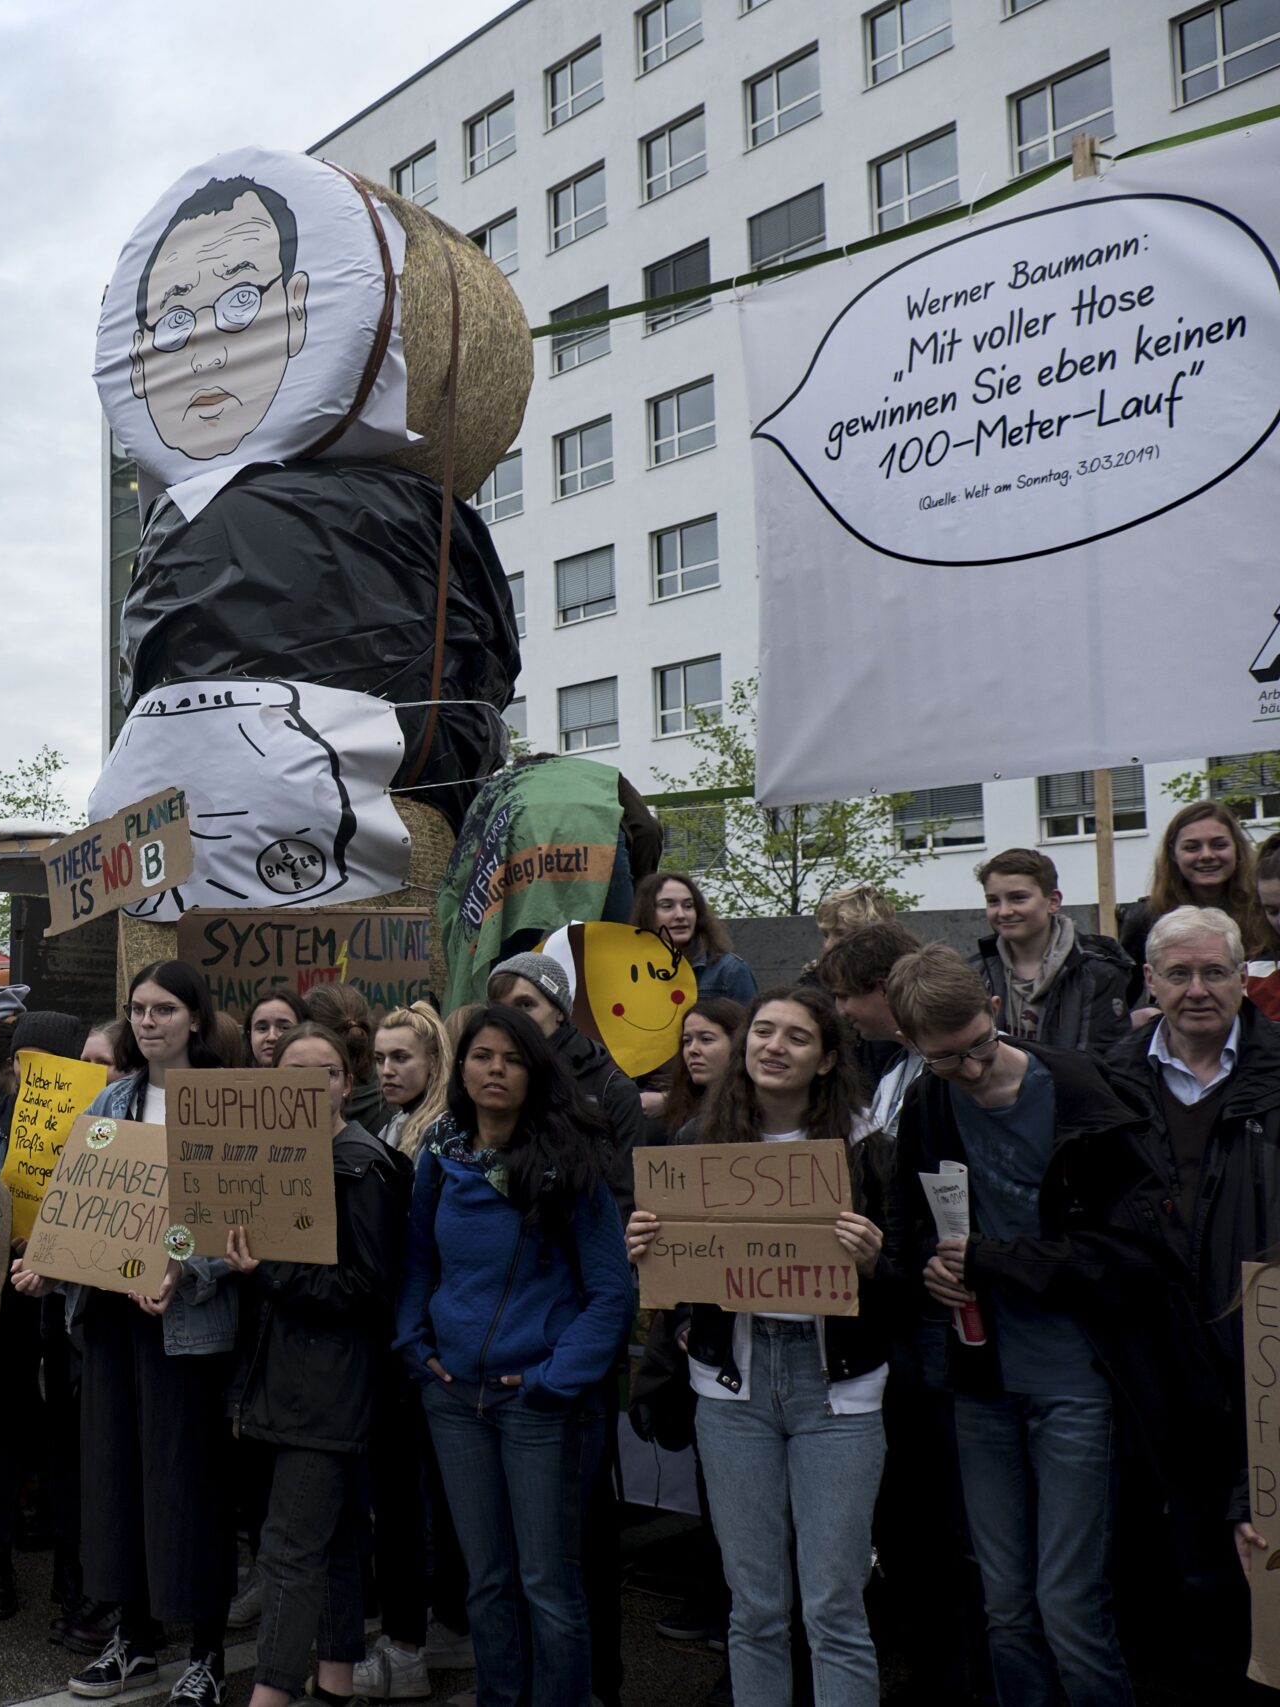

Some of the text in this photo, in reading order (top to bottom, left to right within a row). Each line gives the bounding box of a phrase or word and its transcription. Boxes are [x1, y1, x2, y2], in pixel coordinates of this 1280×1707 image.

[906, 232, 1150, 322] Werner Baumann:
[972, 306, 1056, 354] voller
[1071, 282, 1155, 327] Hose
[824, 314, 1247, 461] gewinnen Sie eben keinen
[918, 490, 962, 511] (Quelle:
[965, 483, 992, 500] Welt
[994, 480, 1012, 495] am
[1016, 467, 1073, 492] Sonntag,
[124, 789, 186, 843] PLANET
[49, 833, 103, 889] THERE
[101, 841, 133, 896] NO
[144, 842, 163, 881] B
[536, 846, 589, 880] jetzt!
[70, 878, 95, 921] IS
[200, 916, 430, 968] SYSTEM CLIMATE
[25, 1061, 52, 1090] Lieber
[177, 1085, 326, 1131] GLYPHOSAT
[55, 1152, 98, 1188] WIR
[183, 1170, 313, 1207] Es bringt uns
[647, 1151, 843, 1209] Mit ESSEN
[40, 1189, 169, 1246] GLYPHOSAT
[184, 1201, 213, 1225] alle
[37, 1232, 59, 1245] SAVE
[652, 1234, 797, 1267] Spielt man
[725, 1264, 852, 1302] NICHT!!!
